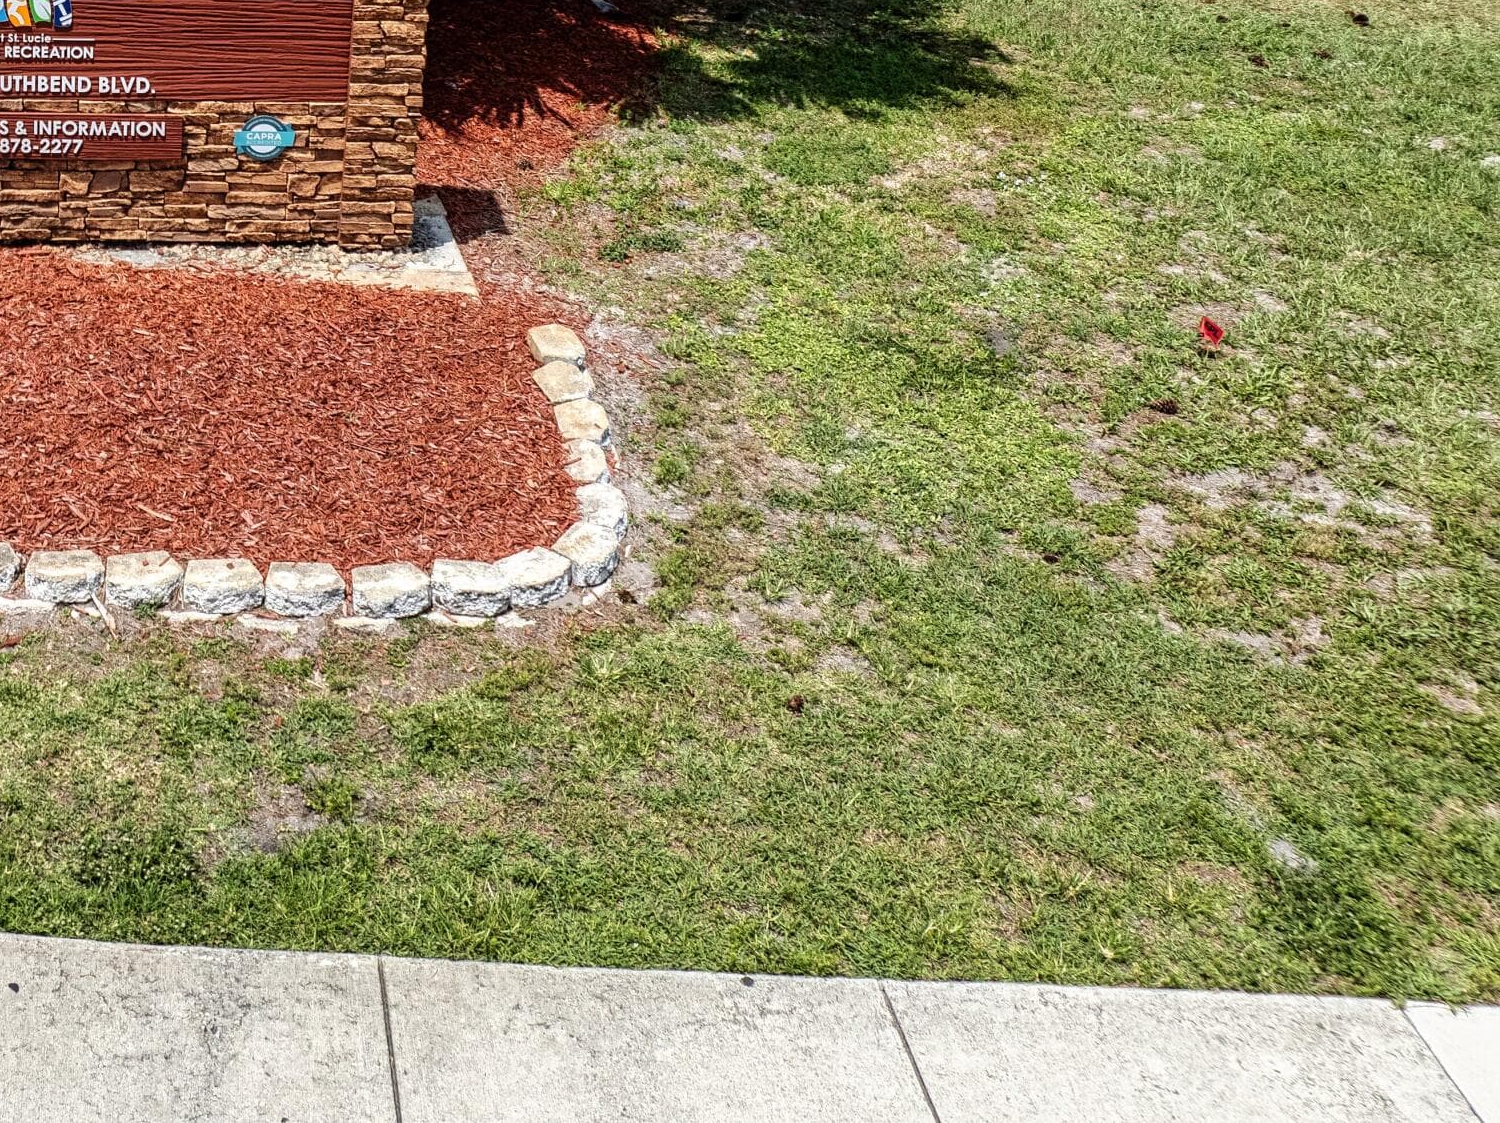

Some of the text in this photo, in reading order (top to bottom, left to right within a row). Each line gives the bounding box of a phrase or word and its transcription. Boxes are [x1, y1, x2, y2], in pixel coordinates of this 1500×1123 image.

[7, 34, 19, 43] St.
[22, 33, 52, 43] Lucie
[4, 46, 94, 59] RECREATION
[99, 77, 156, 94] BLVD.
[15, 120, 27, 135] &
[33, 120, 166, 137] INFORMATION
[246, 132, 282, 141] CAPRA
